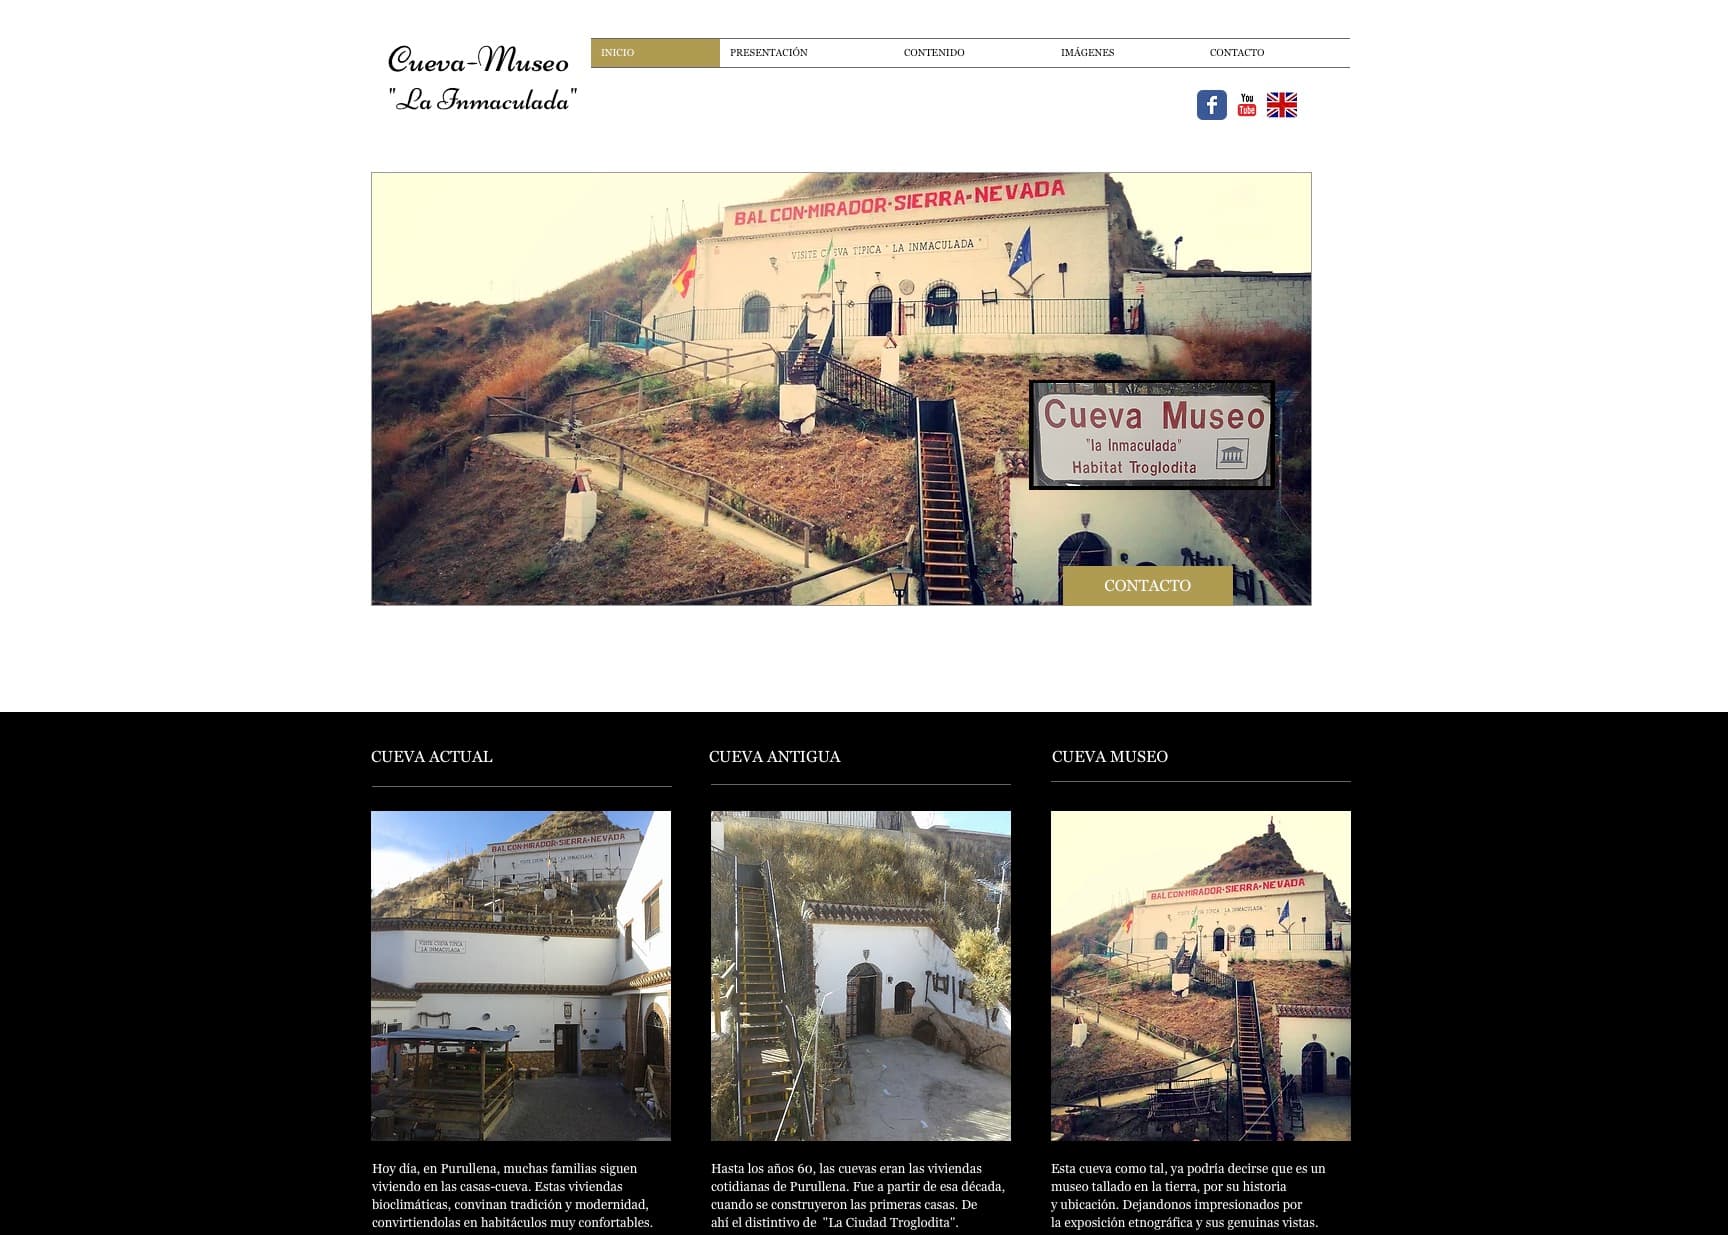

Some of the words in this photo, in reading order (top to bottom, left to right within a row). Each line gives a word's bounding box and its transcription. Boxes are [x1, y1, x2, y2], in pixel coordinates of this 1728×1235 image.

[387, 44, 569, 73] Cueva-Museo
[600, 47, 636, 58] INICIO
[729, 46, 809, 58] PRESENTACIÓN
[903, 48, 966, 58] CONTENIDO
[1060, 46, 1116, 58] IMÁGENES
[1209, 48, 1266, 58] CONTACTO
[389, 87, 433, 111] "La
[436, 87, 578, 111] Inmaculada"
[791, 249, 818, 260] VISITE
[820, 247, 849, 258] CEVA
[908, 238, 975, 252] INMACULADA
[1044, 398, 1142, 430] Cueva
[1162, 400, 1265, 430] Museo
[1108, 437, 1182, 452] Inmaculada"
[1072, 460, 1123, 474] Habitat
[1129, 460, 1197, 477] Troglodita
[1104, 579, 1192, 592] CONTACTO
[370, 750, 427, 763] CUEVA
[428, 750, 494, 763] ACTUAL
[708, 750, 765, 763] CUEVA
[766, 750, 842, 763] ANTIGUA
[1051, 750, 1108, 763] CUEVA
[1110, 750, 1169, 763] MUSEO
[371, 1163, 397, 1177] Hoy
[398, 1162, 421, 1176] día,
[423, 1165, 438, 1174] en
[440, 1162, 501, 1176] Purullena,
[503, 1162, 549, 1174] muchas
[550, 1162, 597, 1174] familias
[599, 1162, 638, 1177] siguen
[711, 1163, 745, 1174] Hasta
[747, 1162, 765, 1174] los
[767, 1163, 795, 1174] años
[797, 1163, 817, 1176] 60,
[818, 1162, 836, 1174] las
[838, 1165, 877, 1174] cuevas
[879, 1165, 906, 1174] eran
[908, 1162, 925, 1174] las
[927, 1162, 983, 1174] viviendas
[1050, 1163, 1077, 1174] Esta
[1078, 1165, 1113, 1174] cueva
[1114, 1165, 1147, 1174] como
[1148, 1162, 1168, 1176] tal,
[1169, 1165, 1185, 1177] ya
[1186, 1162, 1225, 1177] podría
[1227, 1162, 1269, 1174] decirse
[1271, 1165, 1294, 1177] que
[1295, 1165, 1308, 1174] es
[1310, 1165, 1326, 1174] un
[371, 1180, 421, 1192] viviendo
[423, 1183, 439, 1192] en
[440, 1180, 458, 1192] las
[459, 1183, 532, 1192] casas-cueva.
[534, 1181, 566, 1192] Estas
[567, 1180, 623, 1192] viviendas
[710, 1180, 770, 1192] cotidianas
[772, 1180, 787, 1192] de
[789, 1180, 850, 1192] Purullena.
[852, 1181, 875, 1192] Fue
[877, 1183, 885, 1192] a
[886, 1180, 921, 1195] partir
[922, 1180, 937, 1192] de
[939, 1183, 959, 1192] esa
[961, 1180, 1006, 1194] década,
[1050, 1183, 1090, 1192] museo
[1090, 1180, 1132, 1192] tallado
[1134, 1183, 1149, 1192] en
[1151, 1180, 1163, 1192] la
[1164, 1180, 1201, 1194] tierra,
[1203, 1183, 1224, 1195] por
[1225, 1183, 1240, 1192] su
[1242, 1180, 1288, 1192] historia
[371, 1198, 452, 1212] bioclimáticas,
[454, 1198, 508, 1210] convinan
[509, 1198, 563, 1210] tradición
[564, 1201, 573, 1213] y
[574, 1198, 649, 1212] modernidad,
[710, 1198, 754, 1210] cuando
[755, 1201, 769, 1210] se
[770, 1200, 848, 1213] construyeron
[849, 1198, 867, 1210] las
[868, 1198, 922, 1213] primeras
[924, 1201, 959, 1210] casas.
[961, 1199, 978, 1210] De
[1050, 1201, 1059, 1213] y
[1059, 1198, 1120, 1210] ubicación.
[1122, 1198, 1192, 1213] Dejandonos
[1194, 1198, 1280, 1213] impresionados
[1282, 1201, 1303, 1213] por
[371, 1216, 461, 1228] convirtiendolas
[463, 1219, 478, 1228] en
[480, 1216, 548, 1228] habitáculos
[549, 1219, 577, 1231] muy
[578, 1216, 654, 1228] confortables.
[710, 1216, 729, 1228] ahí
[731, 1216, 743, 1228] el
[744, 1216, 800, 1228] distintivo
[802, 1216, 817, 1228] de
[822, 1216, 844, 1228] "La
[845, 1216, 888, 1228] Ciudad
[889, 1216, 959, 1231] Troglodita".
[1050, 1216, 1062, 1228] la
[1064, 1216, 1126, 1231] exposición
[1128, 1216, 1194, 1231] etnográfica
[1195, 1219, 1204, 1231] y
[1205, 1219, 1225, 1228] sus
[1226, 1216, 1280, 1231] genuinas
[1281, 1216, 1319, 1228] vistas.
